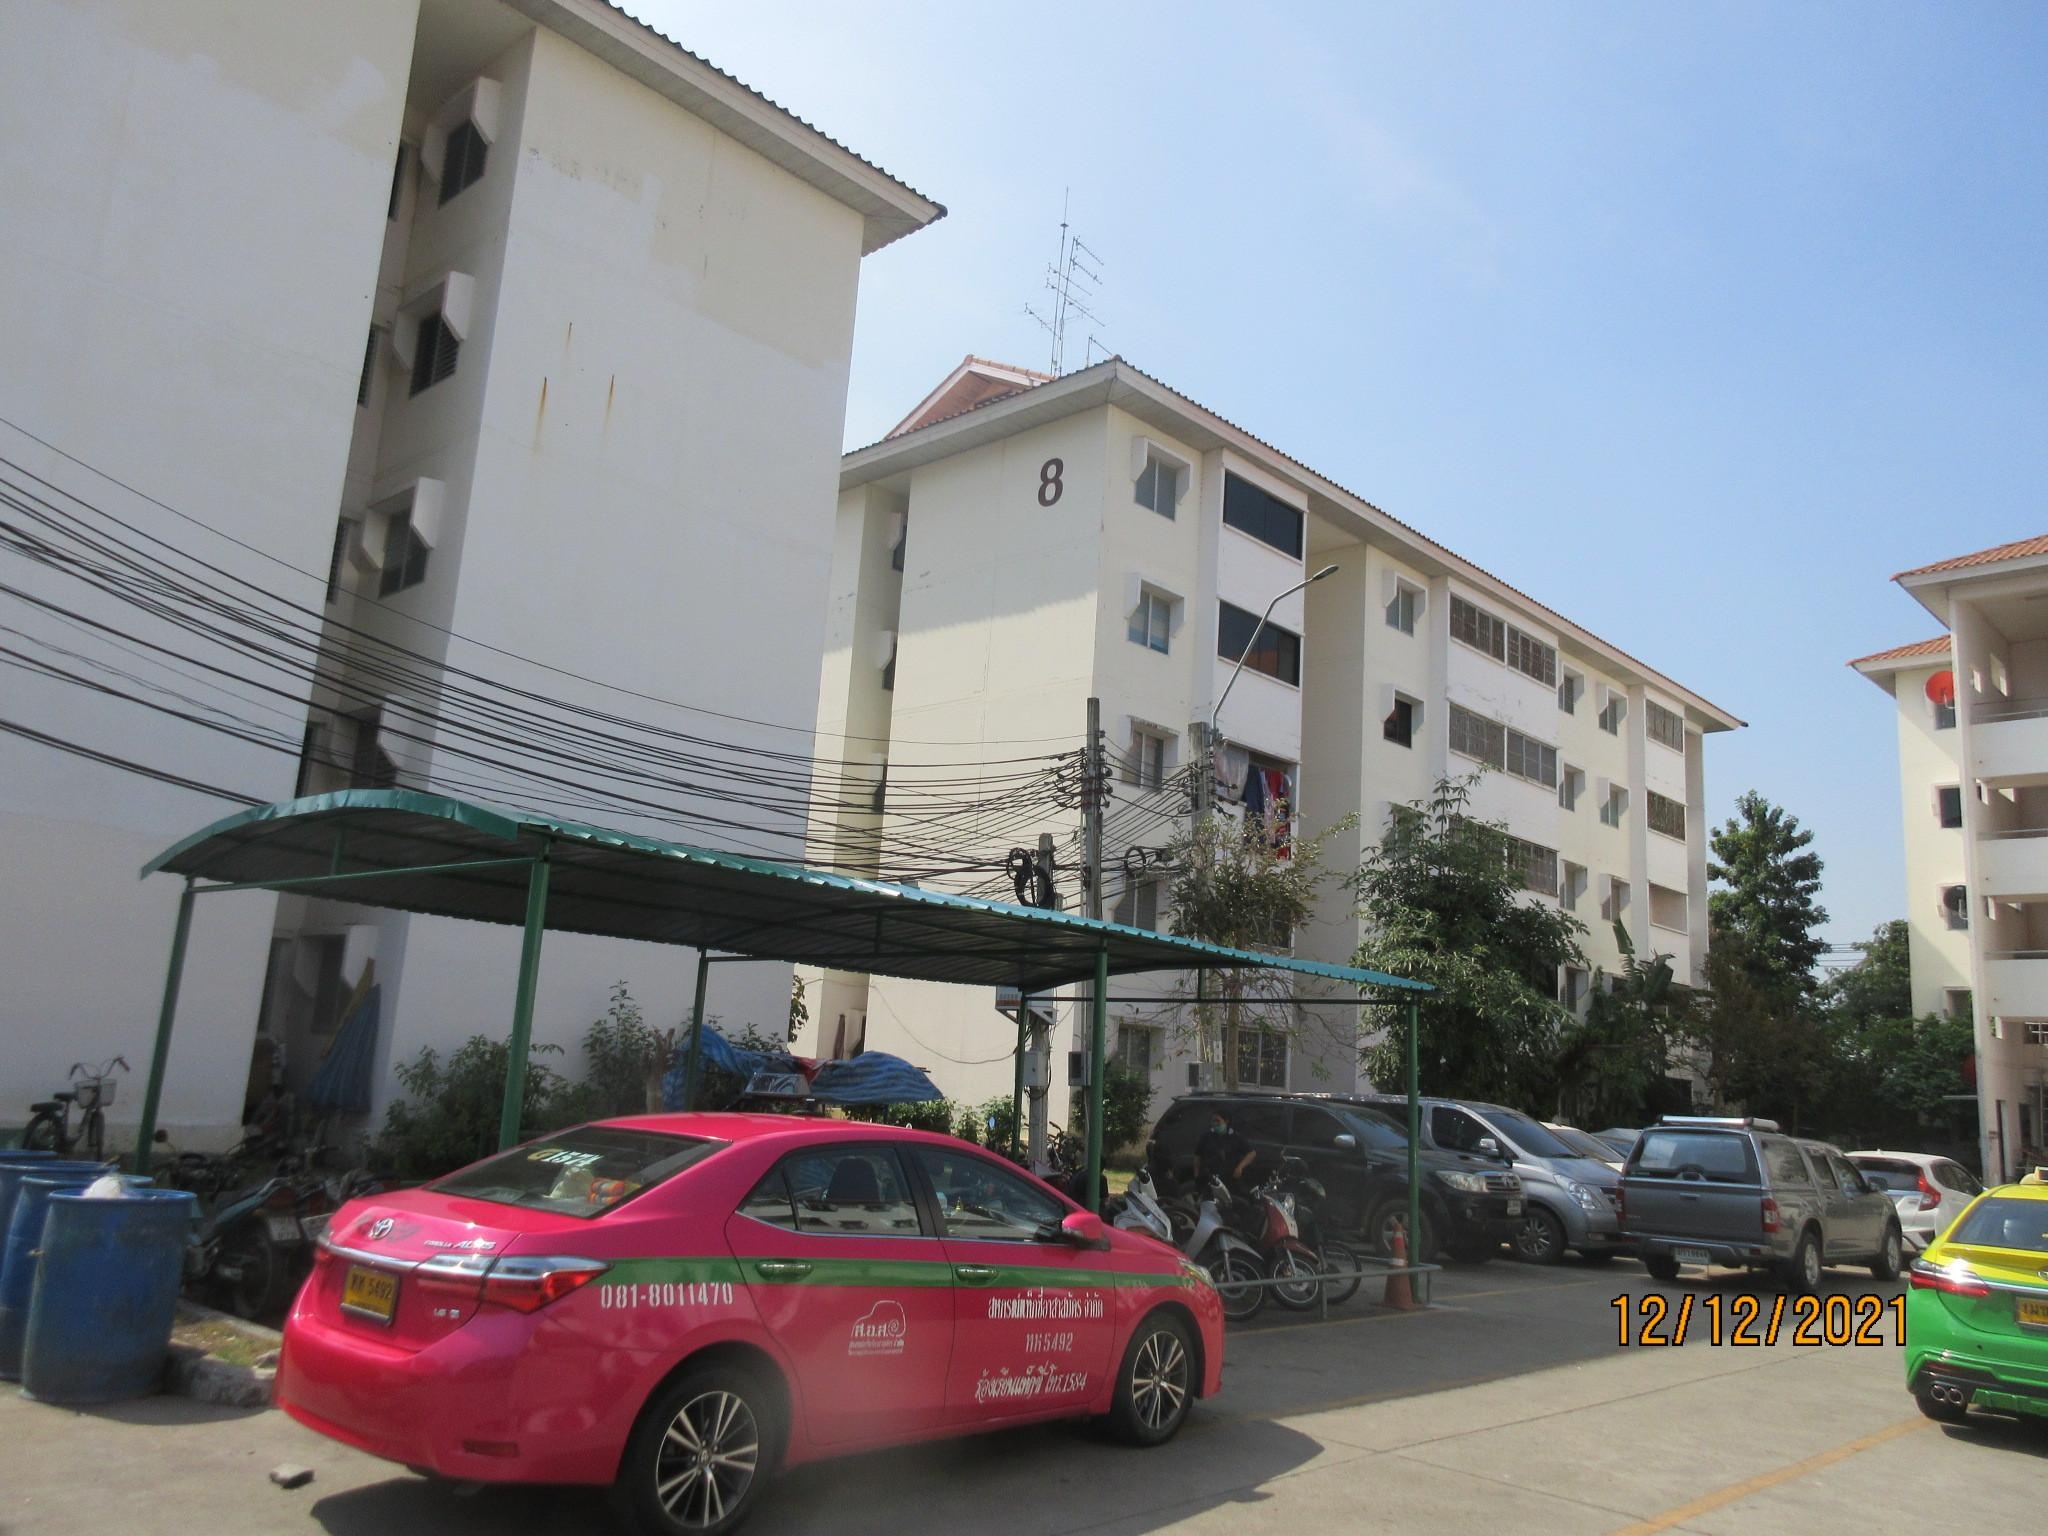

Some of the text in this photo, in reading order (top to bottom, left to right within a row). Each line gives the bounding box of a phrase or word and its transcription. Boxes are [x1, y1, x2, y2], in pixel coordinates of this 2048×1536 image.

[1037, 457, 1064, 508] 8
[368, 1278, 394, 1299] 5492
[600, 1282, 733, 1309] 081-8011470
